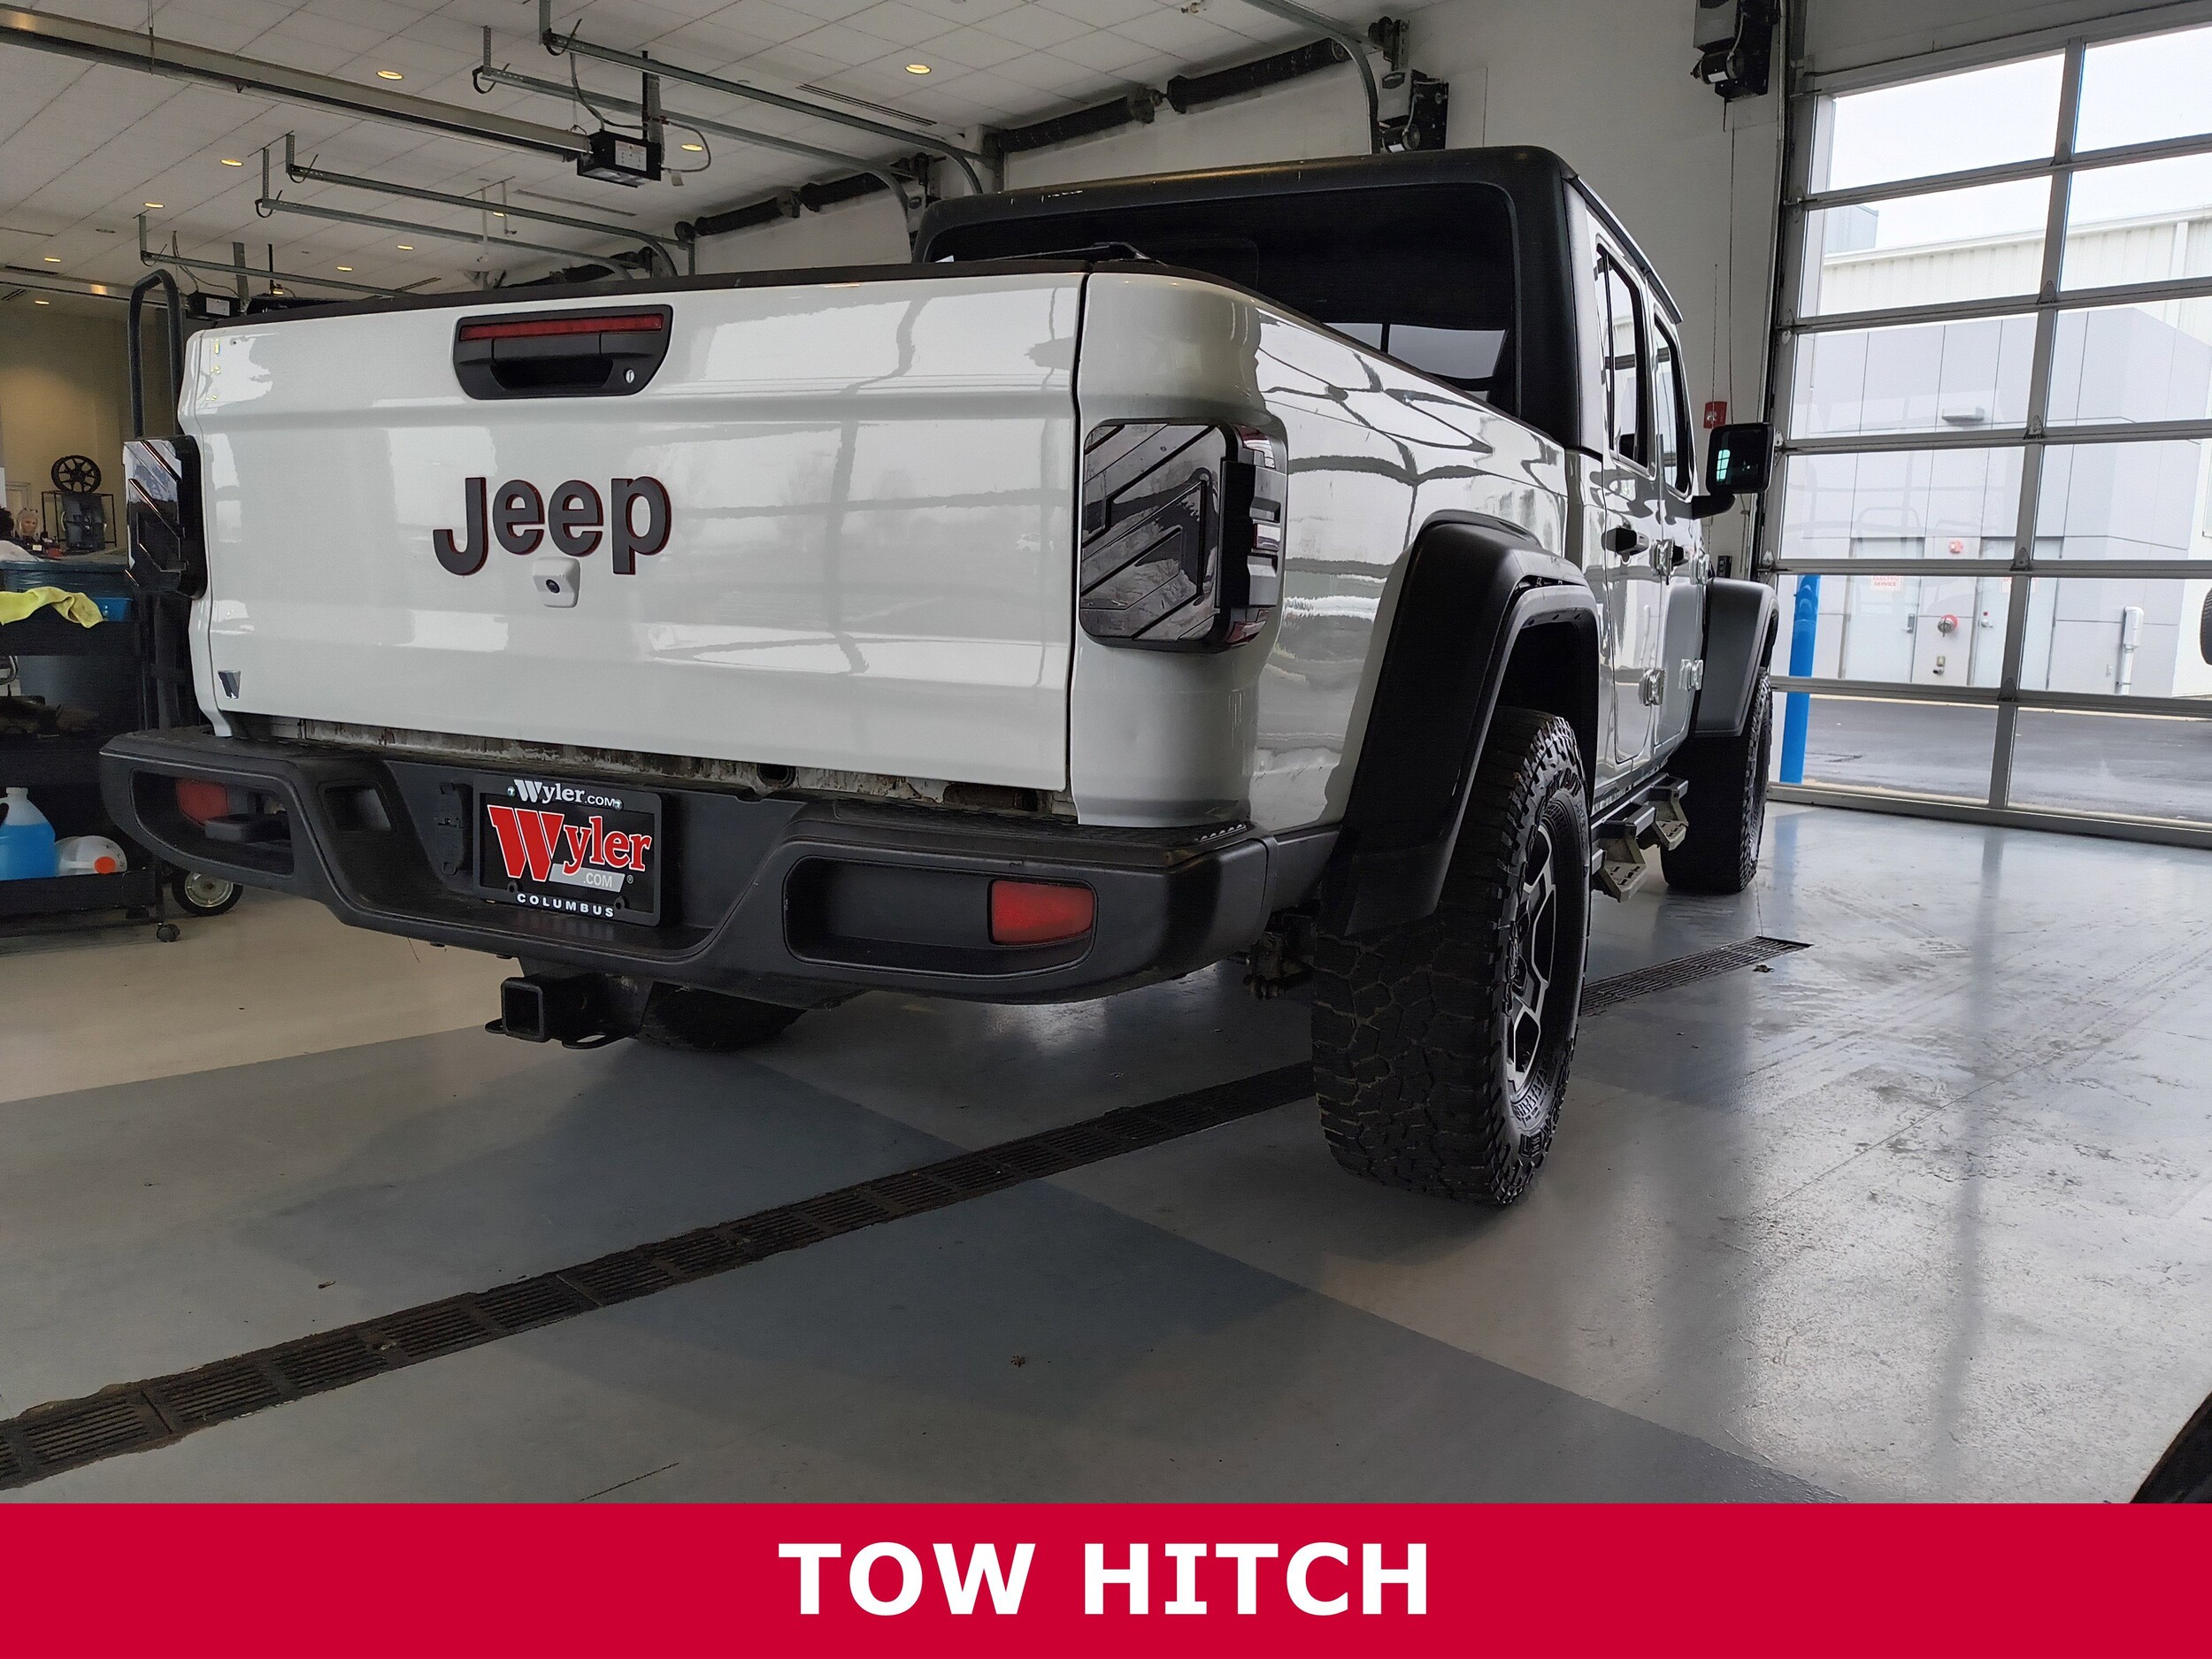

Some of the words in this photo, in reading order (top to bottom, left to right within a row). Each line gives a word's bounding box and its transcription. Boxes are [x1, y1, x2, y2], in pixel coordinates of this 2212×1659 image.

[433, 476, 672, 576] Jeep
[488, 804, 652, 882] Wyler
[517, 893, 614, 918] COLUMBUS
[583, 872, 612, 888] .COM
